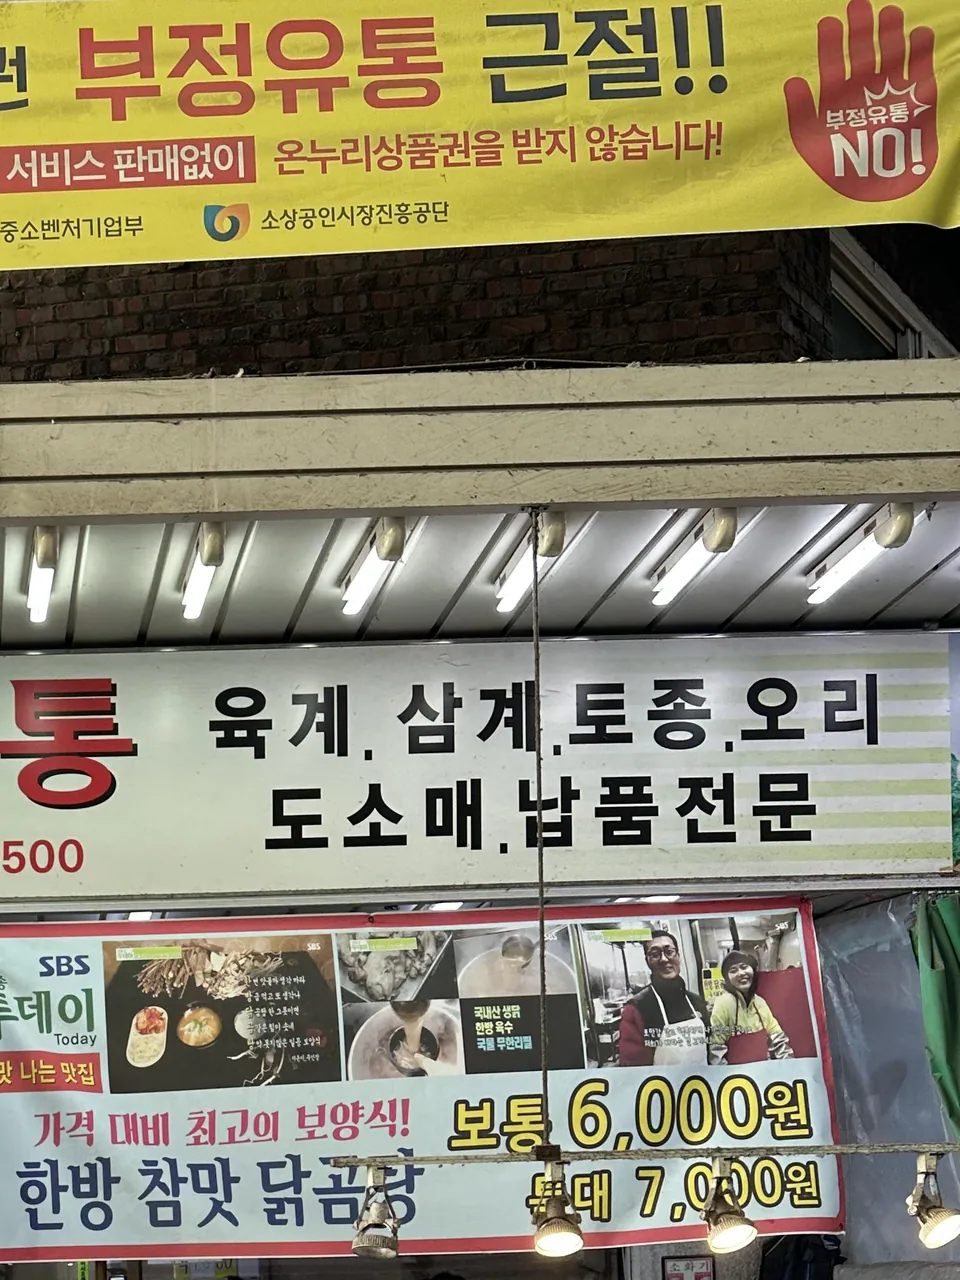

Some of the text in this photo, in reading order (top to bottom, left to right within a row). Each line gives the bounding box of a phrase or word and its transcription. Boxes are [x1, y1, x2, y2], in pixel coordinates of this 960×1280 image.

[75, 17, 444, 122] 부정유통
[482, 4, 728, 104] 근절!!
[825, 102, 911, 132] 부정유통
[8, 147, 106, 189] 서비스
[113, 142, 246, 182] 판매없이
[273, 131, 503, 176] 온누리상품권을
[512, 126, 578, 163] 받지
[586, 121, 724, 166] 않습니다!
[833, 125, 925, 178] NO!
[0, 215, 144, 243] 중소벤처기업부
[261, 202, 450, 232] 소상공인시장진흥공단
[307, 943, 321, 951] SBS
[39, 955, 90, 977] SBS
[474, 1005, 520, 1020] 국내산 생닭
[54, 1033, 97, 1047] Today
[475, 1021, 513, 1035] 한방 육수
[477, 1036, 532, 1051] 국물 무한리필
[20, 1060, 56, 1083] 나는
[60, 1062, 95, 1086] 맛집
[34, 1098, 410, 1148] 가격 대비 최고의 보양식!
[447, 1074, 813, 1154] 보통 6,000원
[15, 1156, 121, 1232] 한방
[137, 1154, 241, 1229] 참맛
[669, 1260, 710, 1272] 소화기
